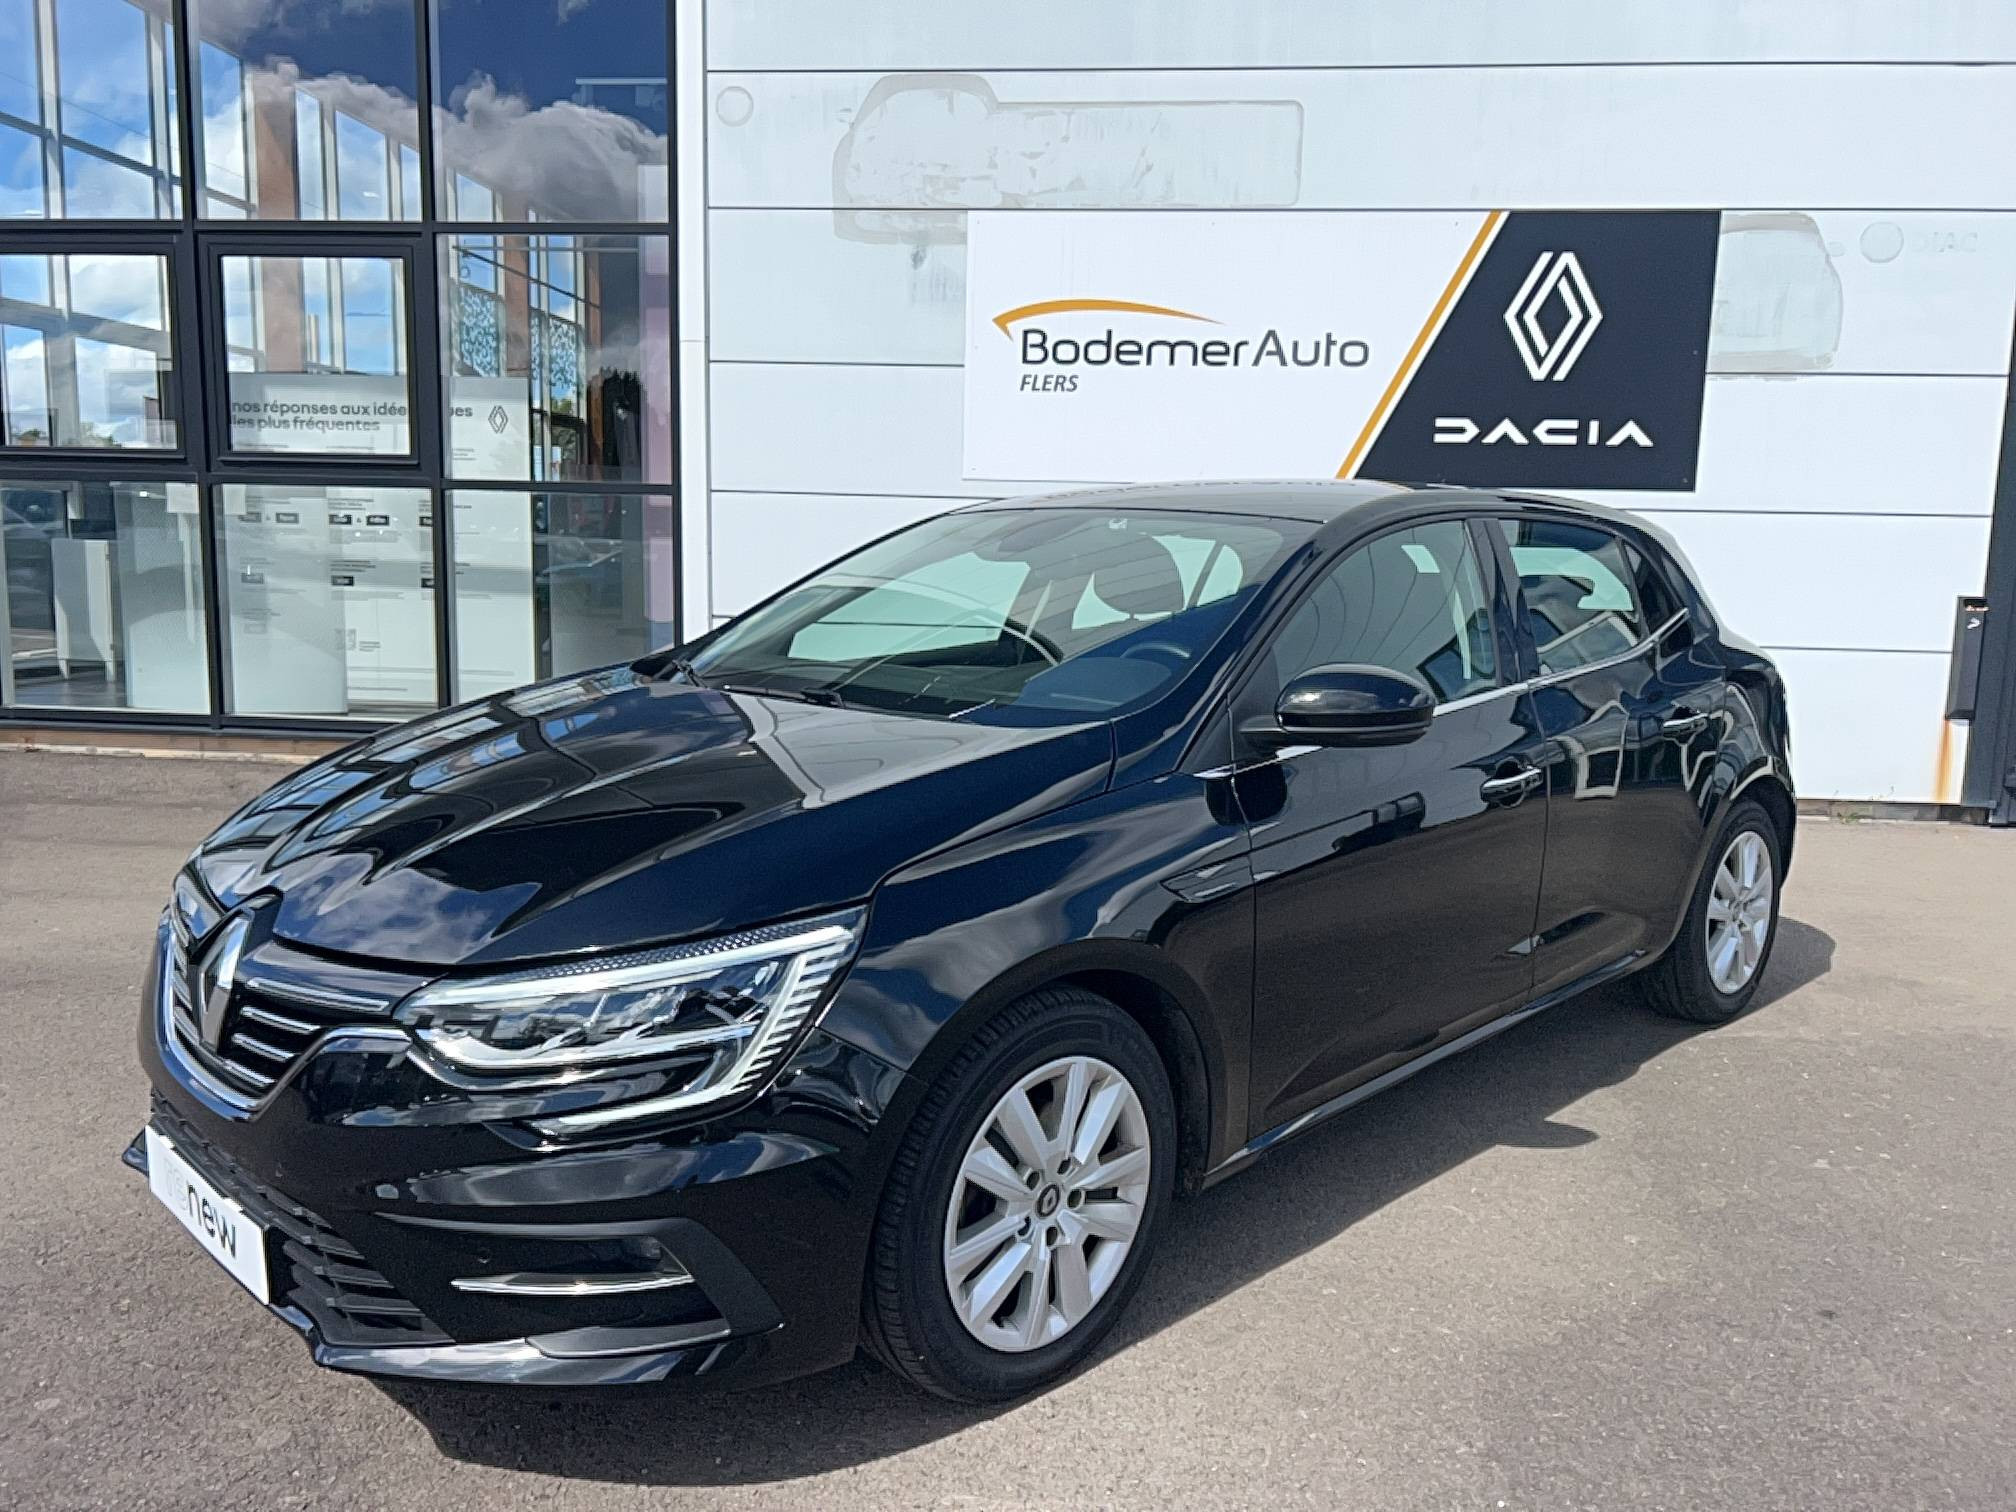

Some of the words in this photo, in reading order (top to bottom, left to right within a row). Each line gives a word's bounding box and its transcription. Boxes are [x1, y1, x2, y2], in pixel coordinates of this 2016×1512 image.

[1020, 374, 1079, 393] FLERS
[231, 401, 261, 414] nos
[263, 399, 338, 417] réponses
[340, 403, 371, 416] aux
[372, 401, 408, 417] idée
[258, 414, 291, 432] plus
[293, 415, 381, 434] fréquentes
[1433, 416, 1654, 448] DACIA
